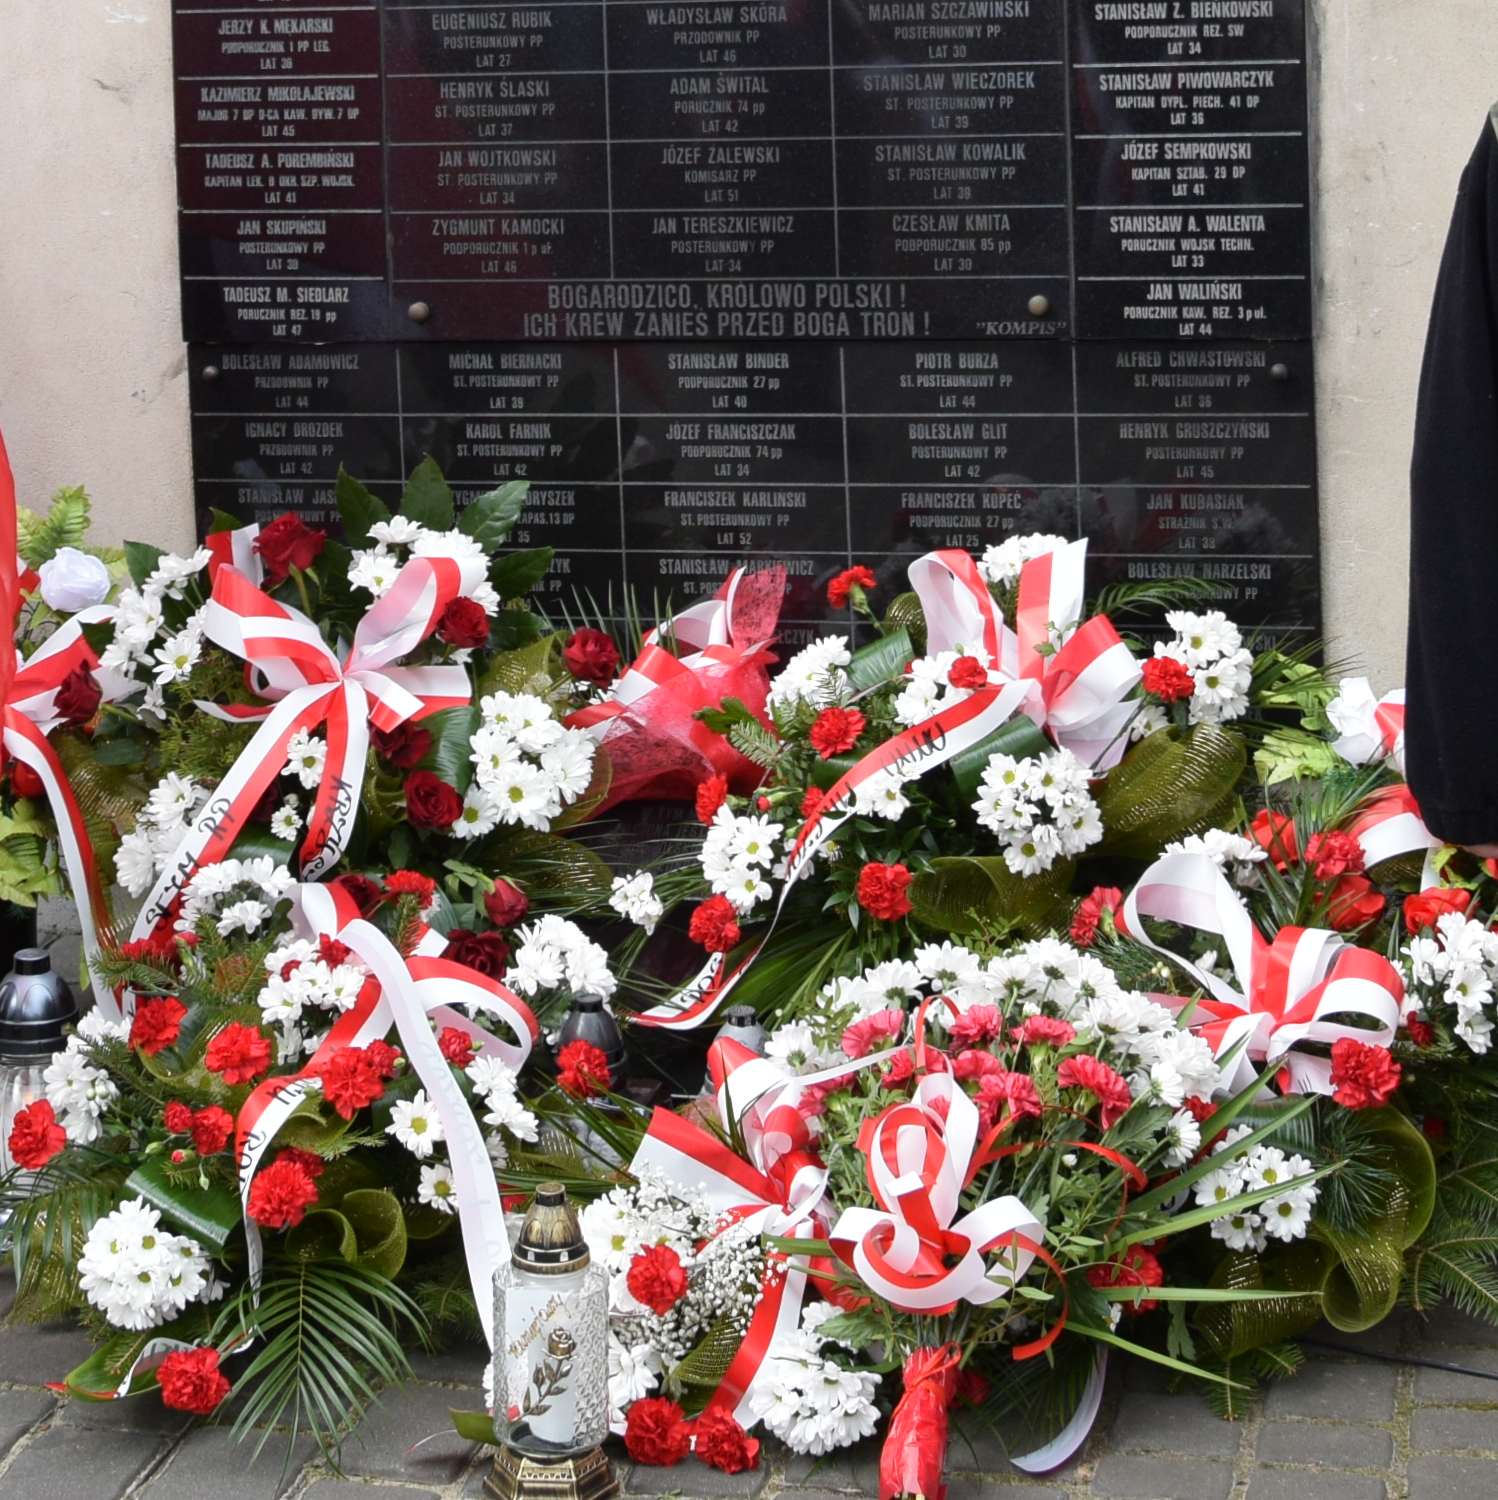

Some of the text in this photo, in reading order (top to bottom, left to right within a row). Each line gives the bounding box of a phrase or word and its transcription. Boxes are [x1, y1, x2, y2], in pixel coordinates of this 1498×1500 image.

[1095, 3, 1167, 20] STANISŁAW
[1173, 3, 1184, 18] Z.
[1125, 25, 1197, 38] PODPORUCZNIK
[1228, 25, 1244, 36] SW
[1168, 42, 1201, 55] LAT 34
[1099, 71, 1274, 91] STANISŁAW PIWOWARCZYK
[1116, 96, 1259, 108] KAPITAN DYPL. PIECH. 41 DP
[1171, 113, 1204, 125] LAT 36
[1121, 140, 1251, 160] JÓZEF SEMPKOWSKI
[1132, 166, 1245, 180] KAPITAN SZTAB. 29 DP
[1173, 184, 1204, 196] LAT 41
[1110, 216, 1265, 232] STANISŁAW A. WALENTA
[1121, 238, 1254, 251] PORUCZNIK WOJSK TECHN.
[1172, 255, 1204, 267] LAT 33
[223, 287, 349, 302] TADEUSZ M. SIEDLARZ
[548, 283, 698, 309] BOGARODZICO,
[707, 281, 806, 309] KRÓLOWO
[816, 283, 891, 308] POLSKI
[1147, 280, 1241, 300] JAN WALIŃSKI
[238, 309, 336, 323] PORUCZNIK REZ. 19 pp
[1124, 307, 1177, 319] PORUCZNIK
[1183, 307, 1206, 318] KAW.
[1213, 307, 1232, 318] REZ.
[1238, 307, 1243, 318] 3
[1246, 309, 1252, 321] p
[273, 325, 301, 335] LAT 47
[524, 313, 556, 336] ICH
[566, 312, 624, 336] KREW
[718, 312, 784, 336] PRZED
[794, 312, 850, 336] BOGA
[861, 312, 915, 336] TRON
[1180, 324, 1212, 335] LAT 44
[916, 353, 998, 369] PIOTR BURZA
[900, 375, 1012, 387] ST. POSTERUNKOWY PP
[940, 395, 975, 408] LAT 44
[198, 797, 235, 840] RP
